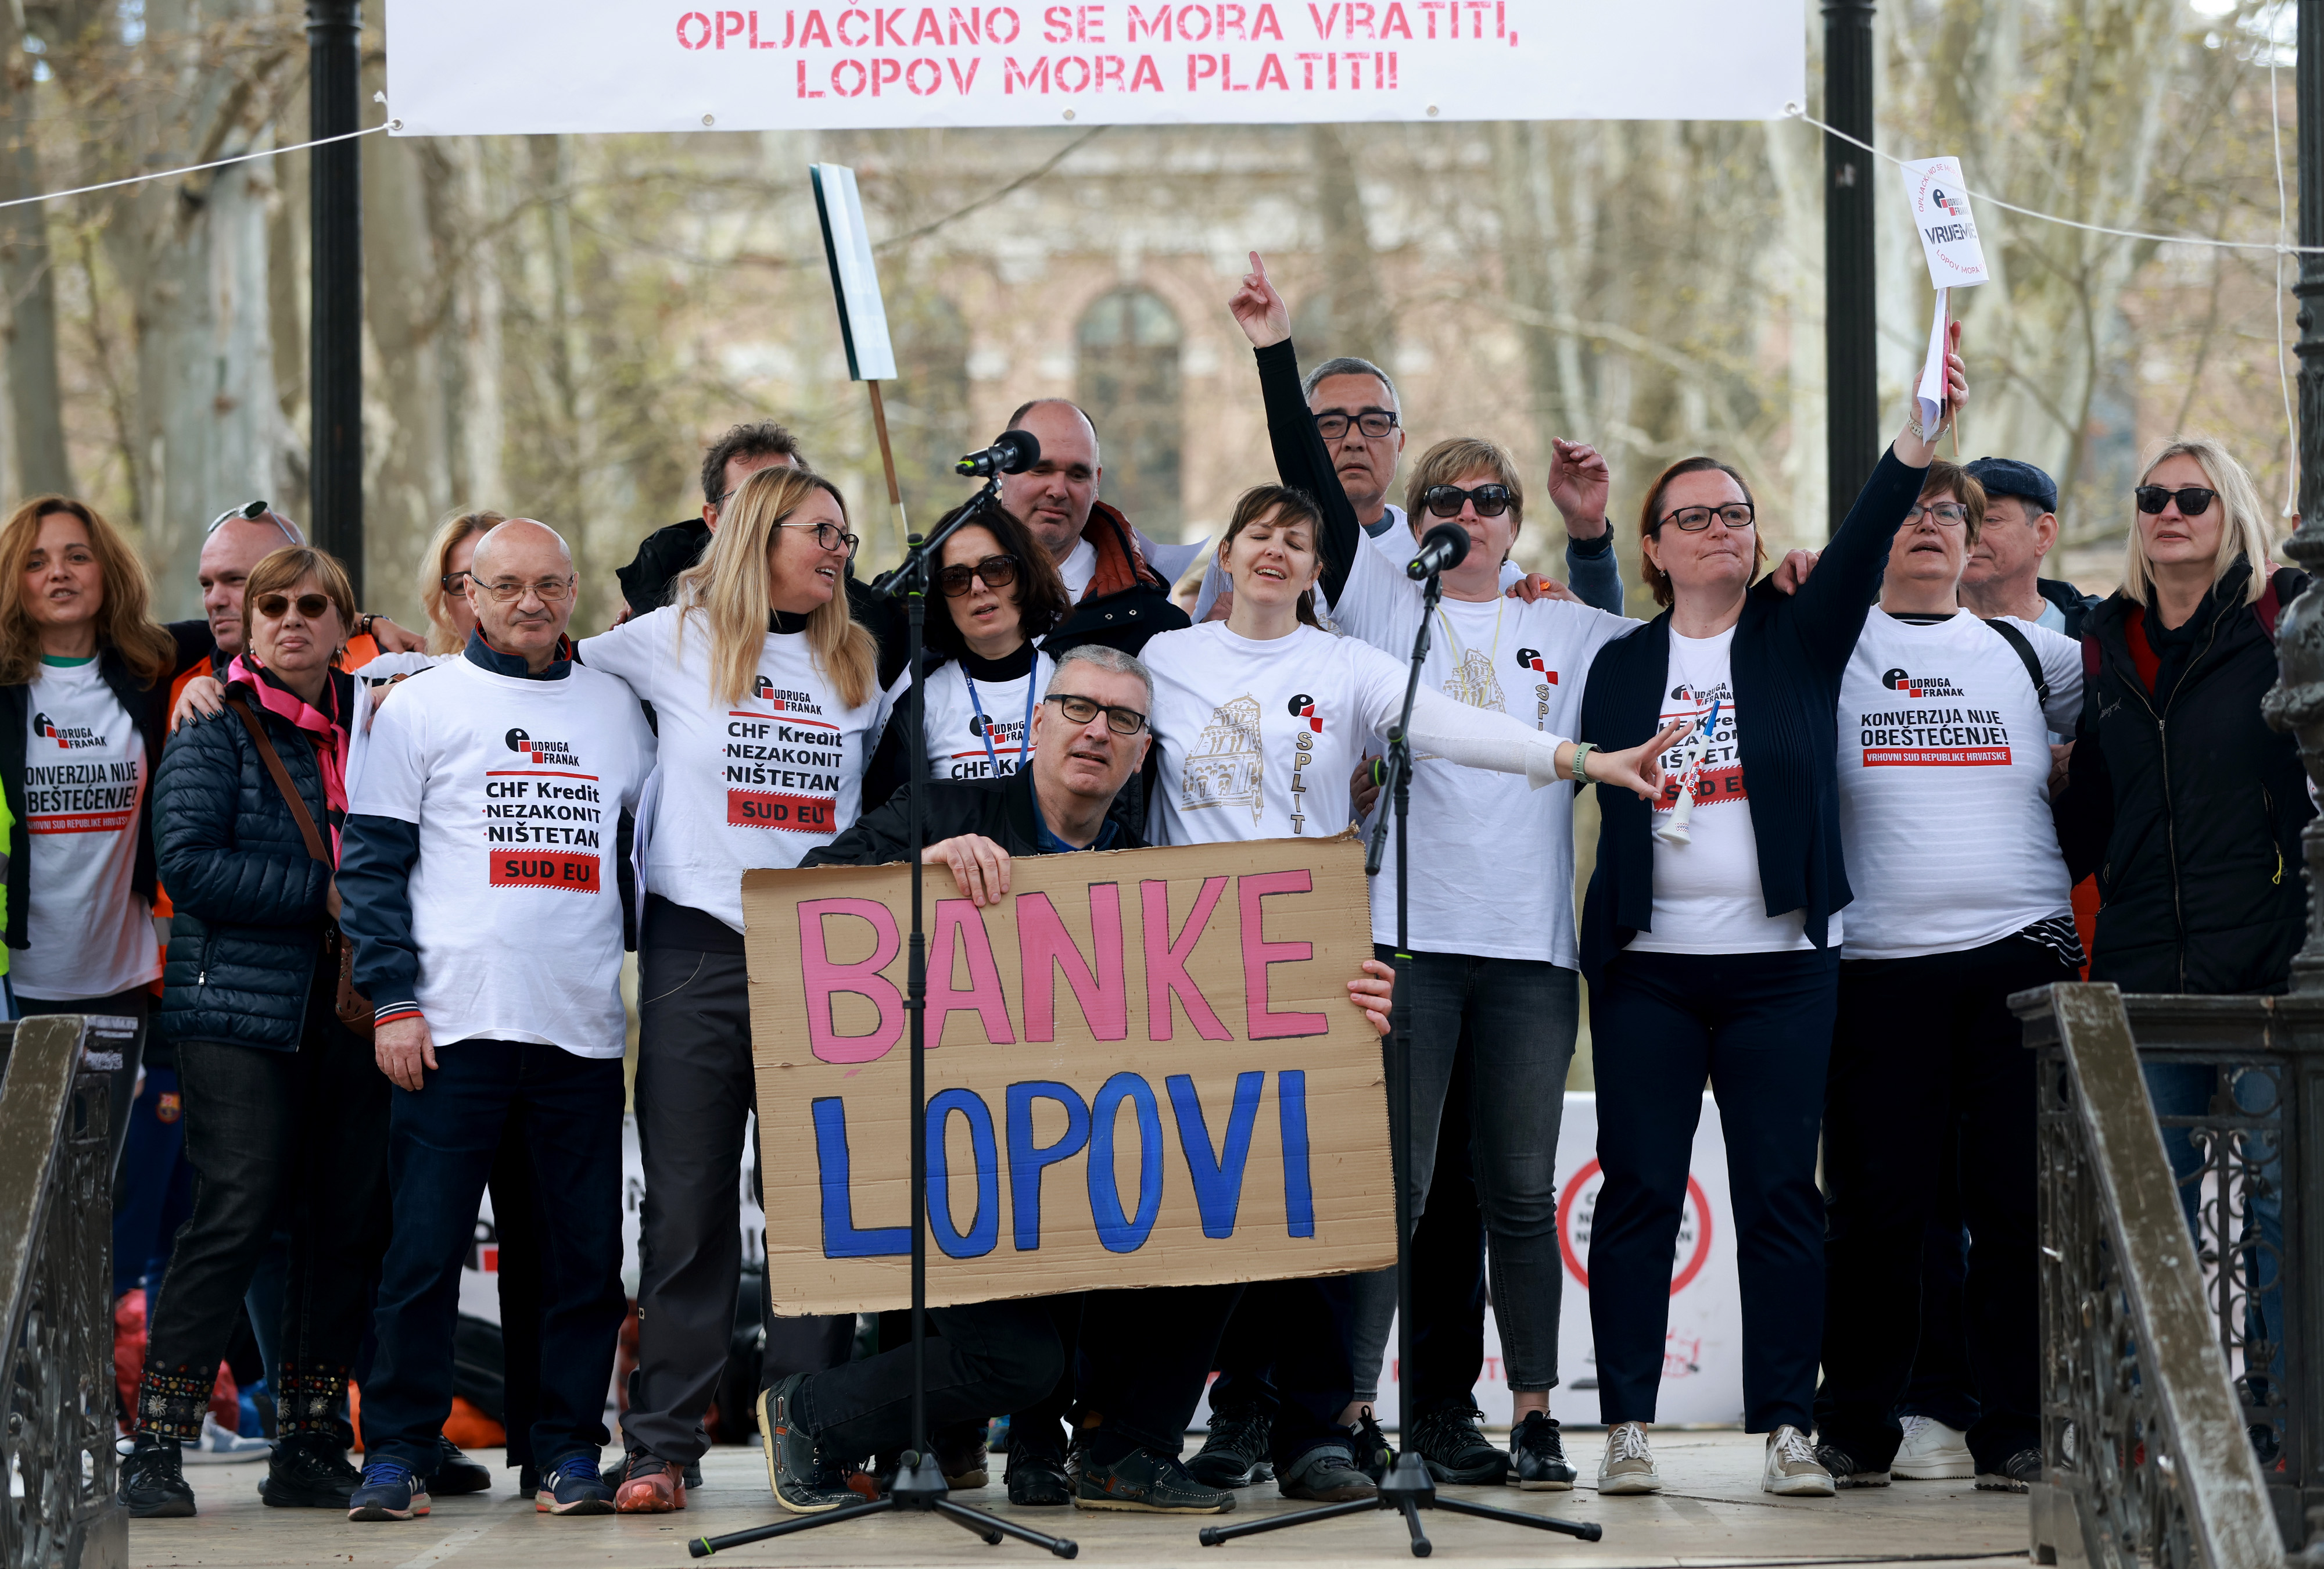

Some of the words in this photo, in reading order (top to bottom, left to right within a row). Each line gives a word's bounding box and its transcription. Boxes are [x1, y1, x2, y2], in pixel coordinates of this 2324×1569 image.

[676, 0, 1020, 50] OPLJAČKANO
[1043, 5, 1106, 44] SE
[1127, 3, 1284, 42] MORA
[1307, 1, 1518, 47] VRATITI,
[796, 57, 981, 98] LOPOV
[1004, 55, 1164, 94] MORA
[1924, 223, 1977, 245] VRIJEME
[1936, 249, 1959, 271] LOPOV
[1961, 266, 1979, 274] MORA
[1910, 678, 1951, 689] UDRUGA
[1923, 688, 1965, 697] FRANAK
[774, 689, 810, 703] UDRUGA
[1705, 691, 1734, 705] FRANA
[786, 701, 822, 715] FRANAK
[1861, 709, 1964, 726] KONVERZIJA
[1967, 709, 2003, 725] NIJE
[56, 728, 93, 739] UDRUGA
[727, 722, 770, 739] CHF
[779, 726, 842, 747] Kredit
[994, 721, 1024, 734] UDRUG
[1006, 732, 1024, 741] FRA
[1861, 724, 2009, 747] OBEŠTEĆENJE!
[70, 736, 107, 749] FRANAK
[532, 741, 569, 753] UDRUGA
[544, 753, 580, 766] FRANAK
[727, 743, 842, 768] NEZAKONIT
[1867, 753, 1902, 762] VRHOVNI
[1903, 753, 1920, 762] SUD
[1921, 753, 1965, 762] REPUBLIKE
[1966, 751, 2007, 761] HRVATSKE
[24, 764, 107, 786] ONVERZIJA
[110, 761, 138, 782] NIJE
[727, 762, 839, 791] NIŠTETAN
[951, 761, 990, 779] CHF
[1690, 765, 1699, 787] CROATIA
[486, 782, 529, 798] CHF
[537, 782, 600, 803] Kredit
[1290, 732, 1313, 834] SPLIT
[1664, 782, 1716, 800] SD
[27, 784, 138, 813] BEŠTEĆENJE!
[53, 820, 65, 829] SUD
[67, 818, 101, 828] REPUBLIKE
[103, 816, 127, 826] HRVATS
[486, 804, 601, 824] NEZAKONIT
[742, 801, 788, 821] SUD
[798, 805, 824, 823] EU
[489, 821, 599, 848] NIŠTETAN
[505, 859, 555, 878] SUD
[564, 862, 590, 882] EU
[797, 868, 1329, 1064] BANKE
[812, 1070, 1316, 1259] LOPOVI
